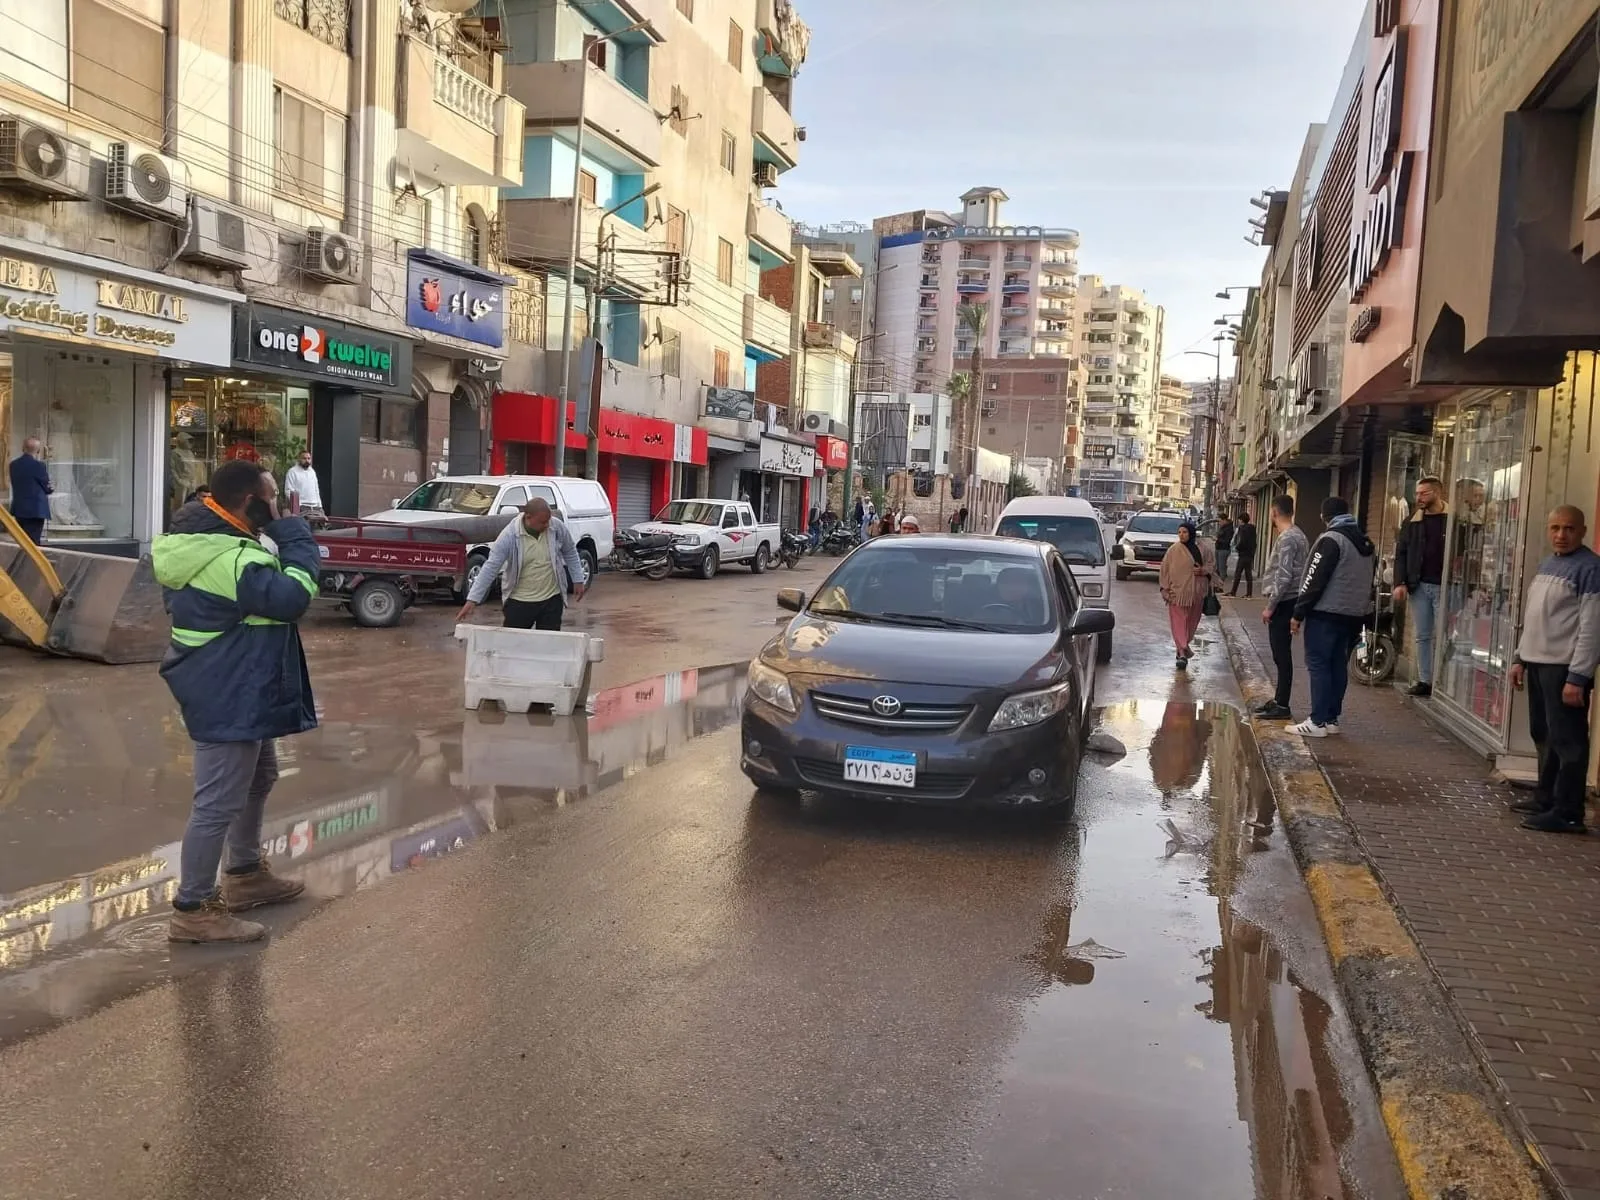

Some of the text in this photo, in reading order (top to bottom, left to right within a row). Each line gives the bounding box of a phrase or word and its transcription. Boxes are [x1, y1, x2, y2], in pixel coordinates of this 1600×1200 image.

[96, 280, 189, 324] KAMAL
[259, 325, 391, 370] one 2 twelve
[368, 372, 383, 381] WEAR
